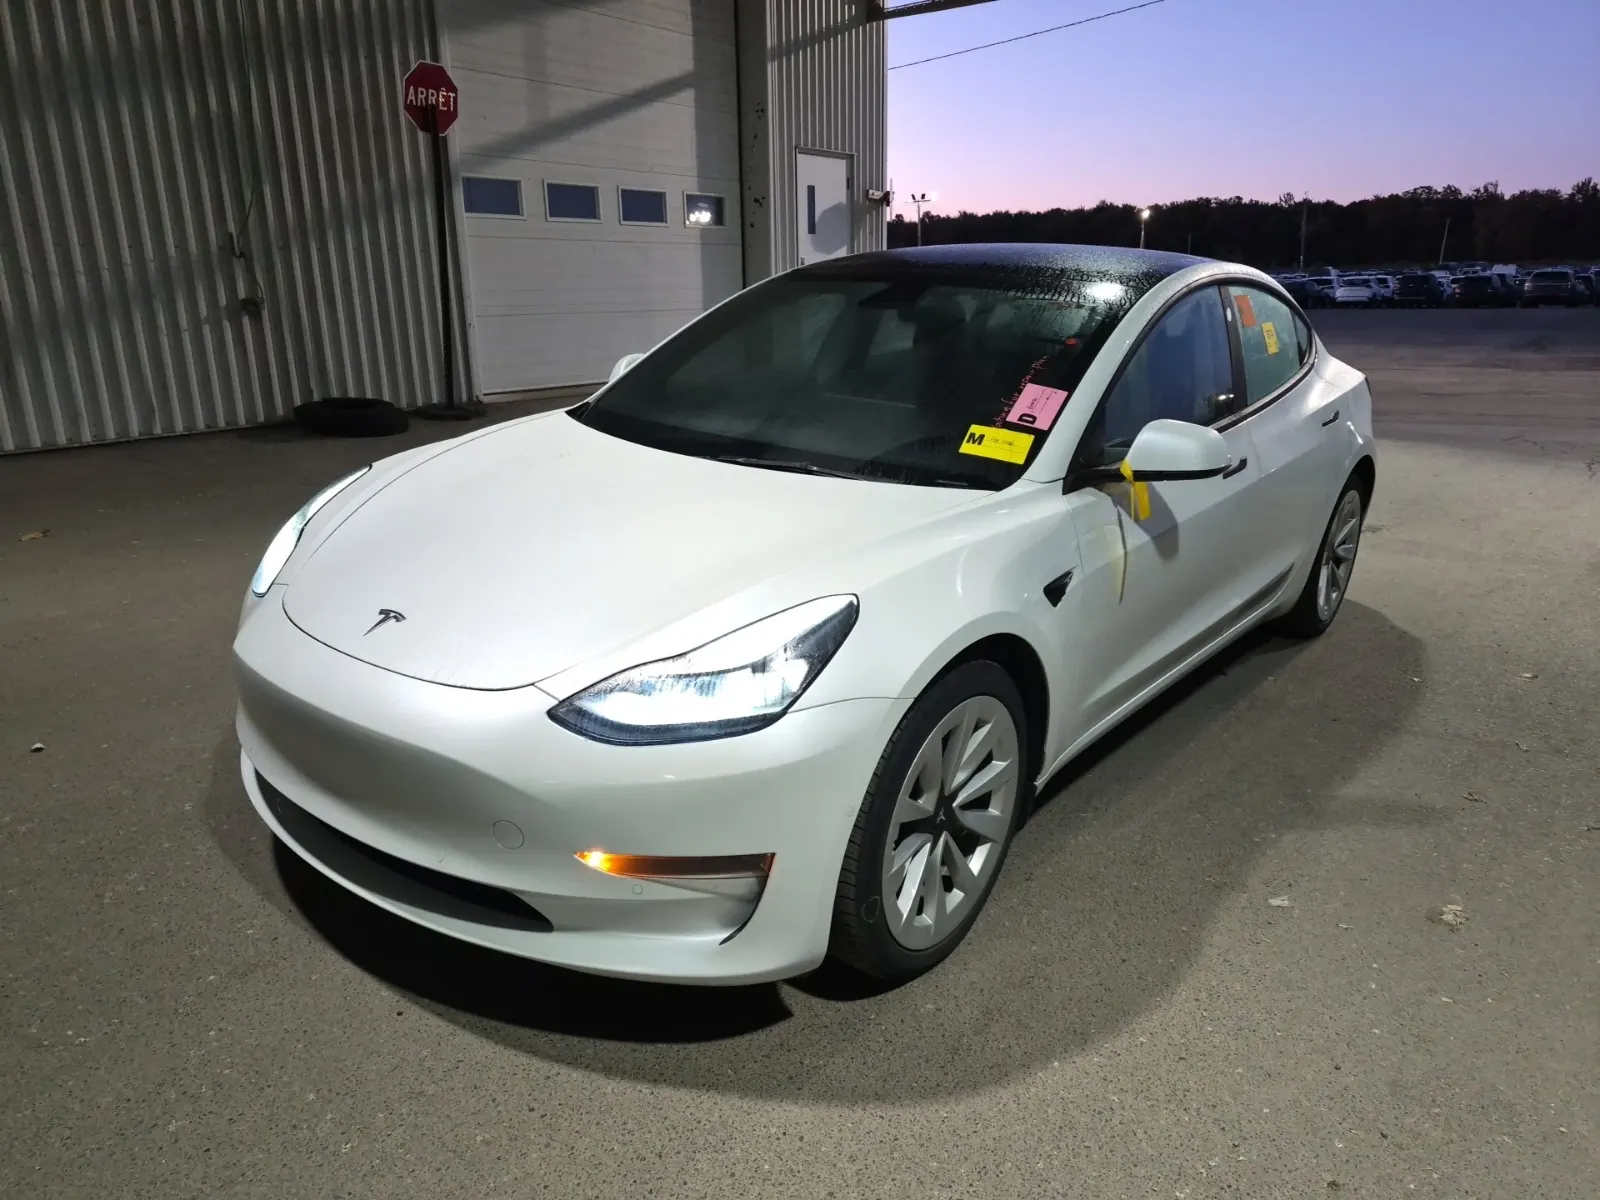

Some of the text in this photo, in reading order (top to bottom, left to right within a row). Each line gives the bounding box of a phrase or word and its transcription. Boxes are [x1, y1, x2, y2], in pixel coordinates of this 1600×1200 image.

[406, 85, 456, 112] ARRÊT
[1017, 412, 1037, 425] D
[966, 432, 986, 446] M
